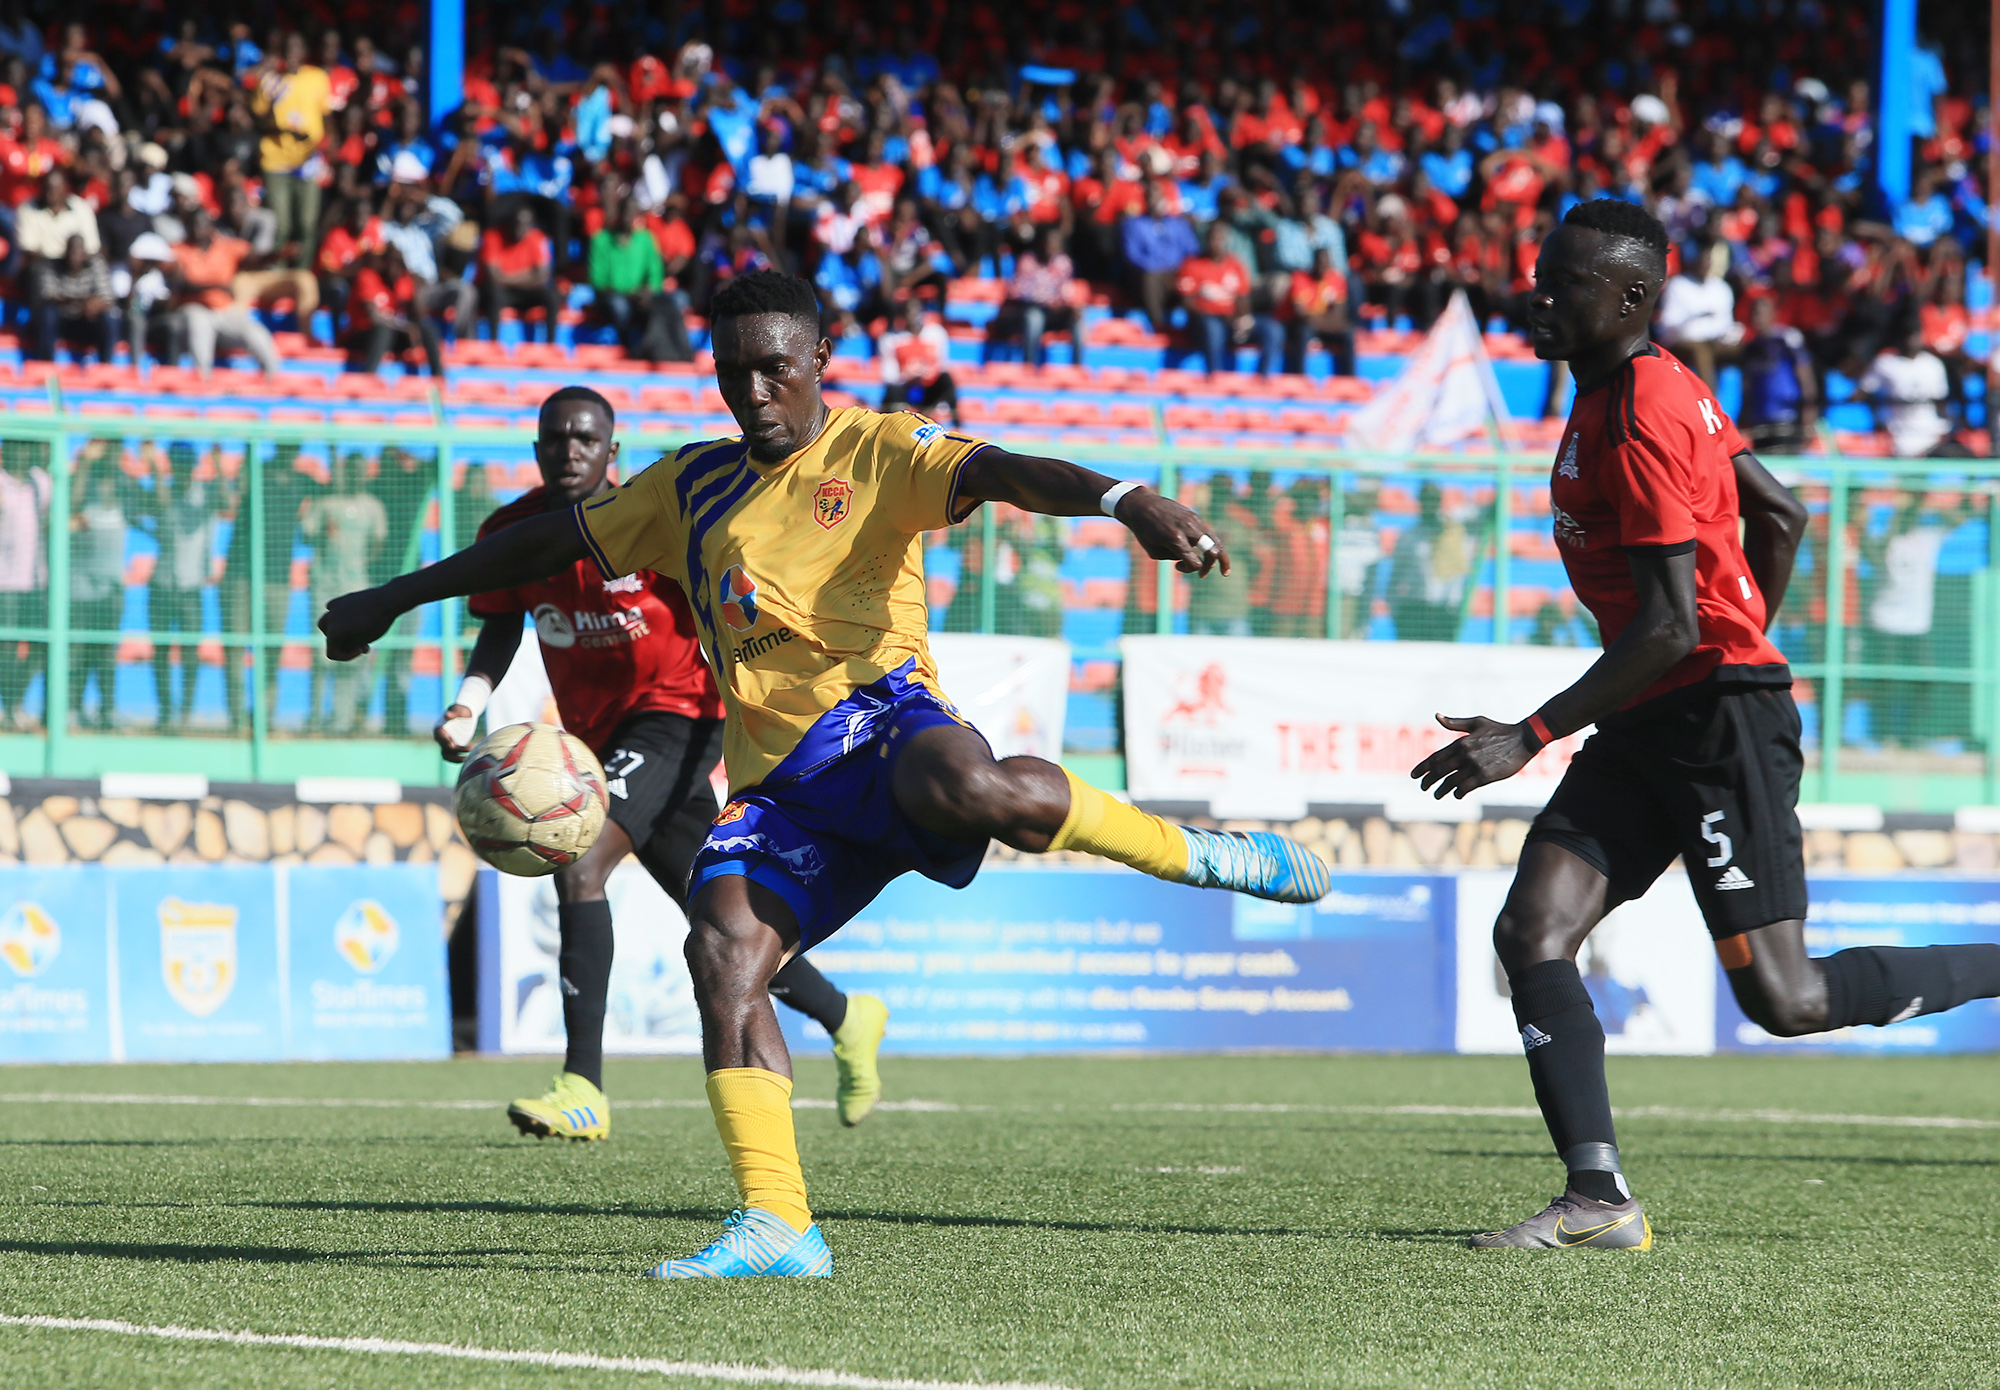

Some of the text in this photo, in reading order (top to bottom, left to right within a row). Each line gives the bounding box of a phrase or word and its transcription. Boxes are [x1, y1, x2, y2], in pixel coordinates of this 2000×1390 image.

[822, 486, 845, 498] KCCA
[574, 605, 644, 631] Hima
[580, 622, 651, 649] cement
[733, 627, 800, 663] arTime
[1275, 723, 1342, 772] THE
[604, 749, 645, 777] 27
[1701, 810, 1733, 867] 5
